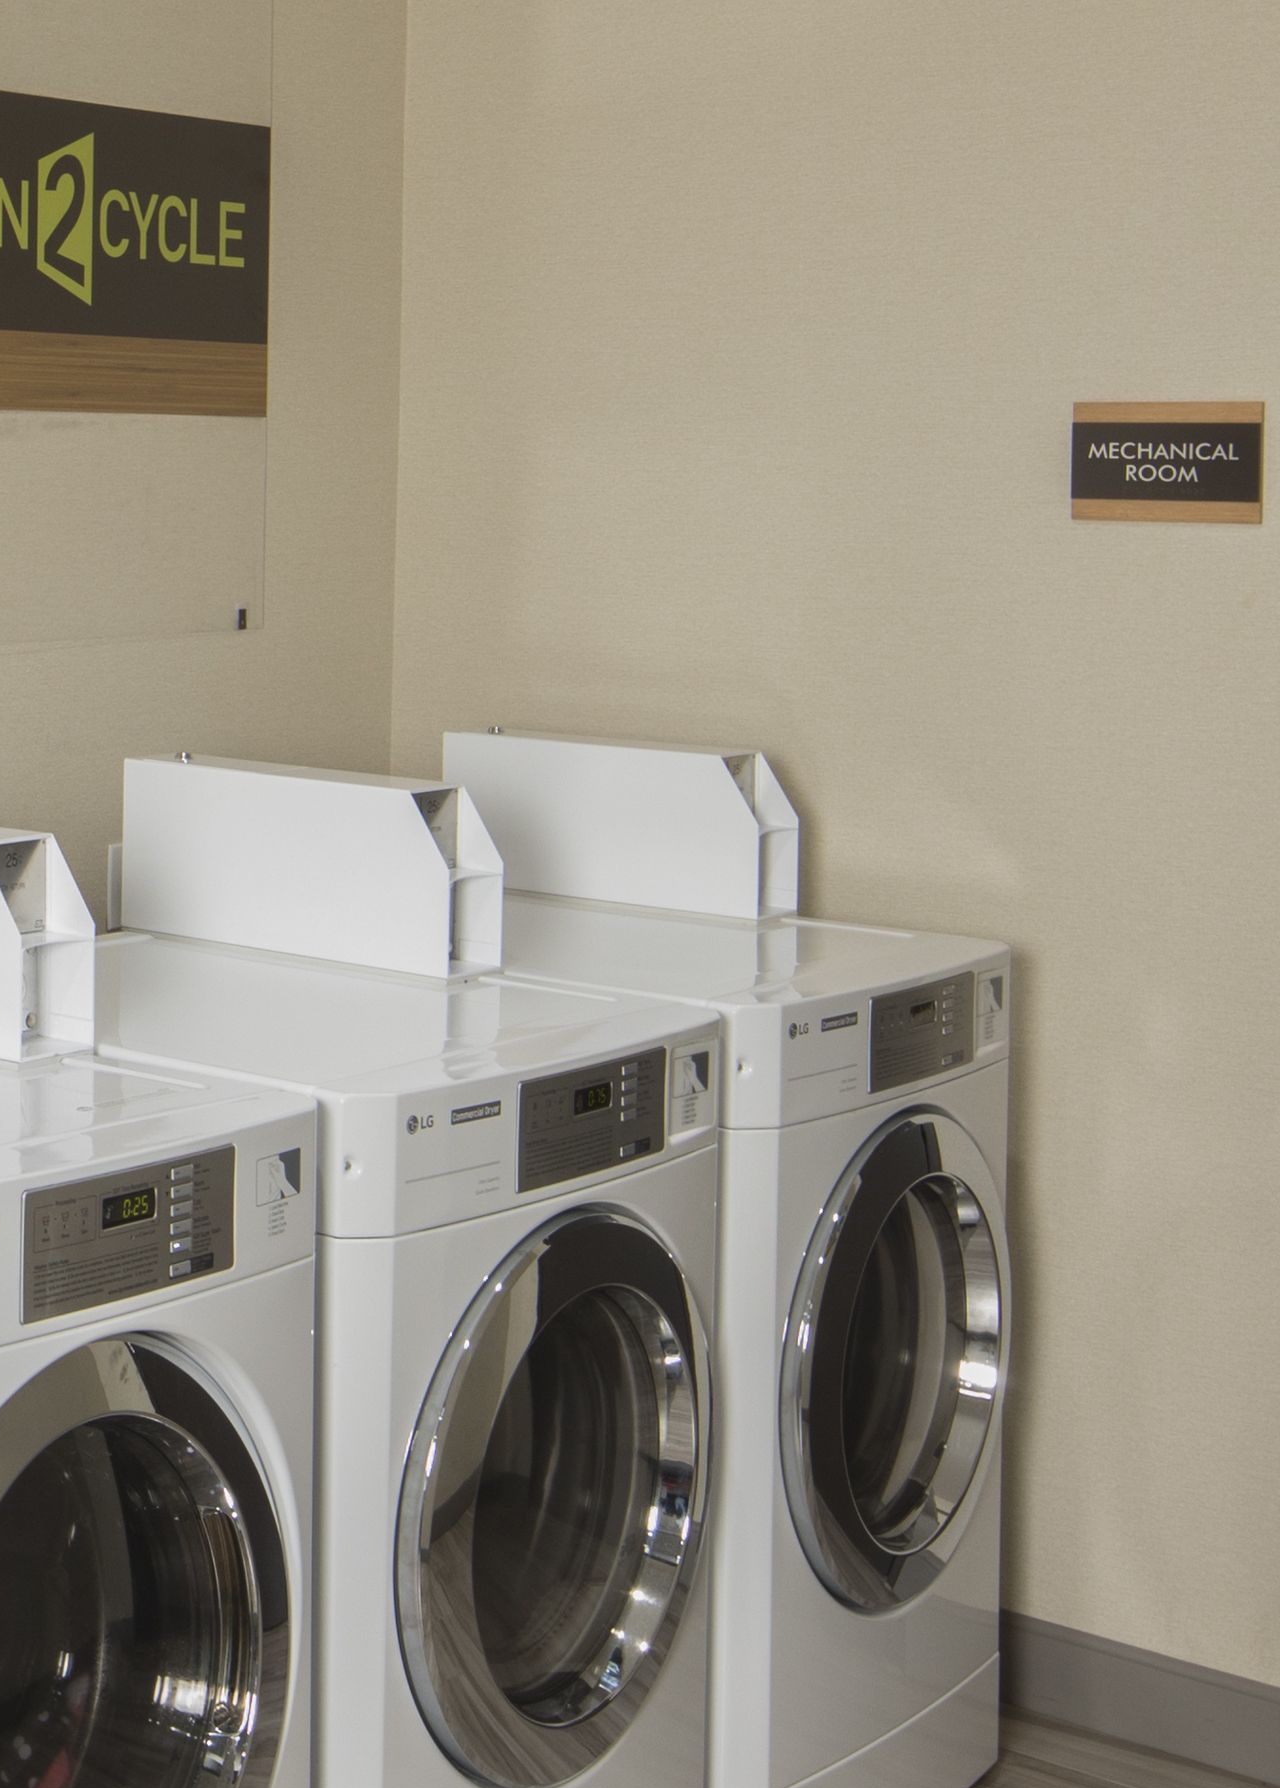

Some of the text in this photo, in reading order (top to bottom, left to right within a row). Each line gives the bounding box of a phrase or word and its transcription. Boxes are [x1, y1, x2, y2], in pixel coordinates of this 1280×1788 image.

[1088, 442, 1239, 461] MECHANICAL
[1125, 464, 1199, 482] ROOM
[798, 1022, 809, 1035] LG
[420, 1115, 434, 1129] LG
